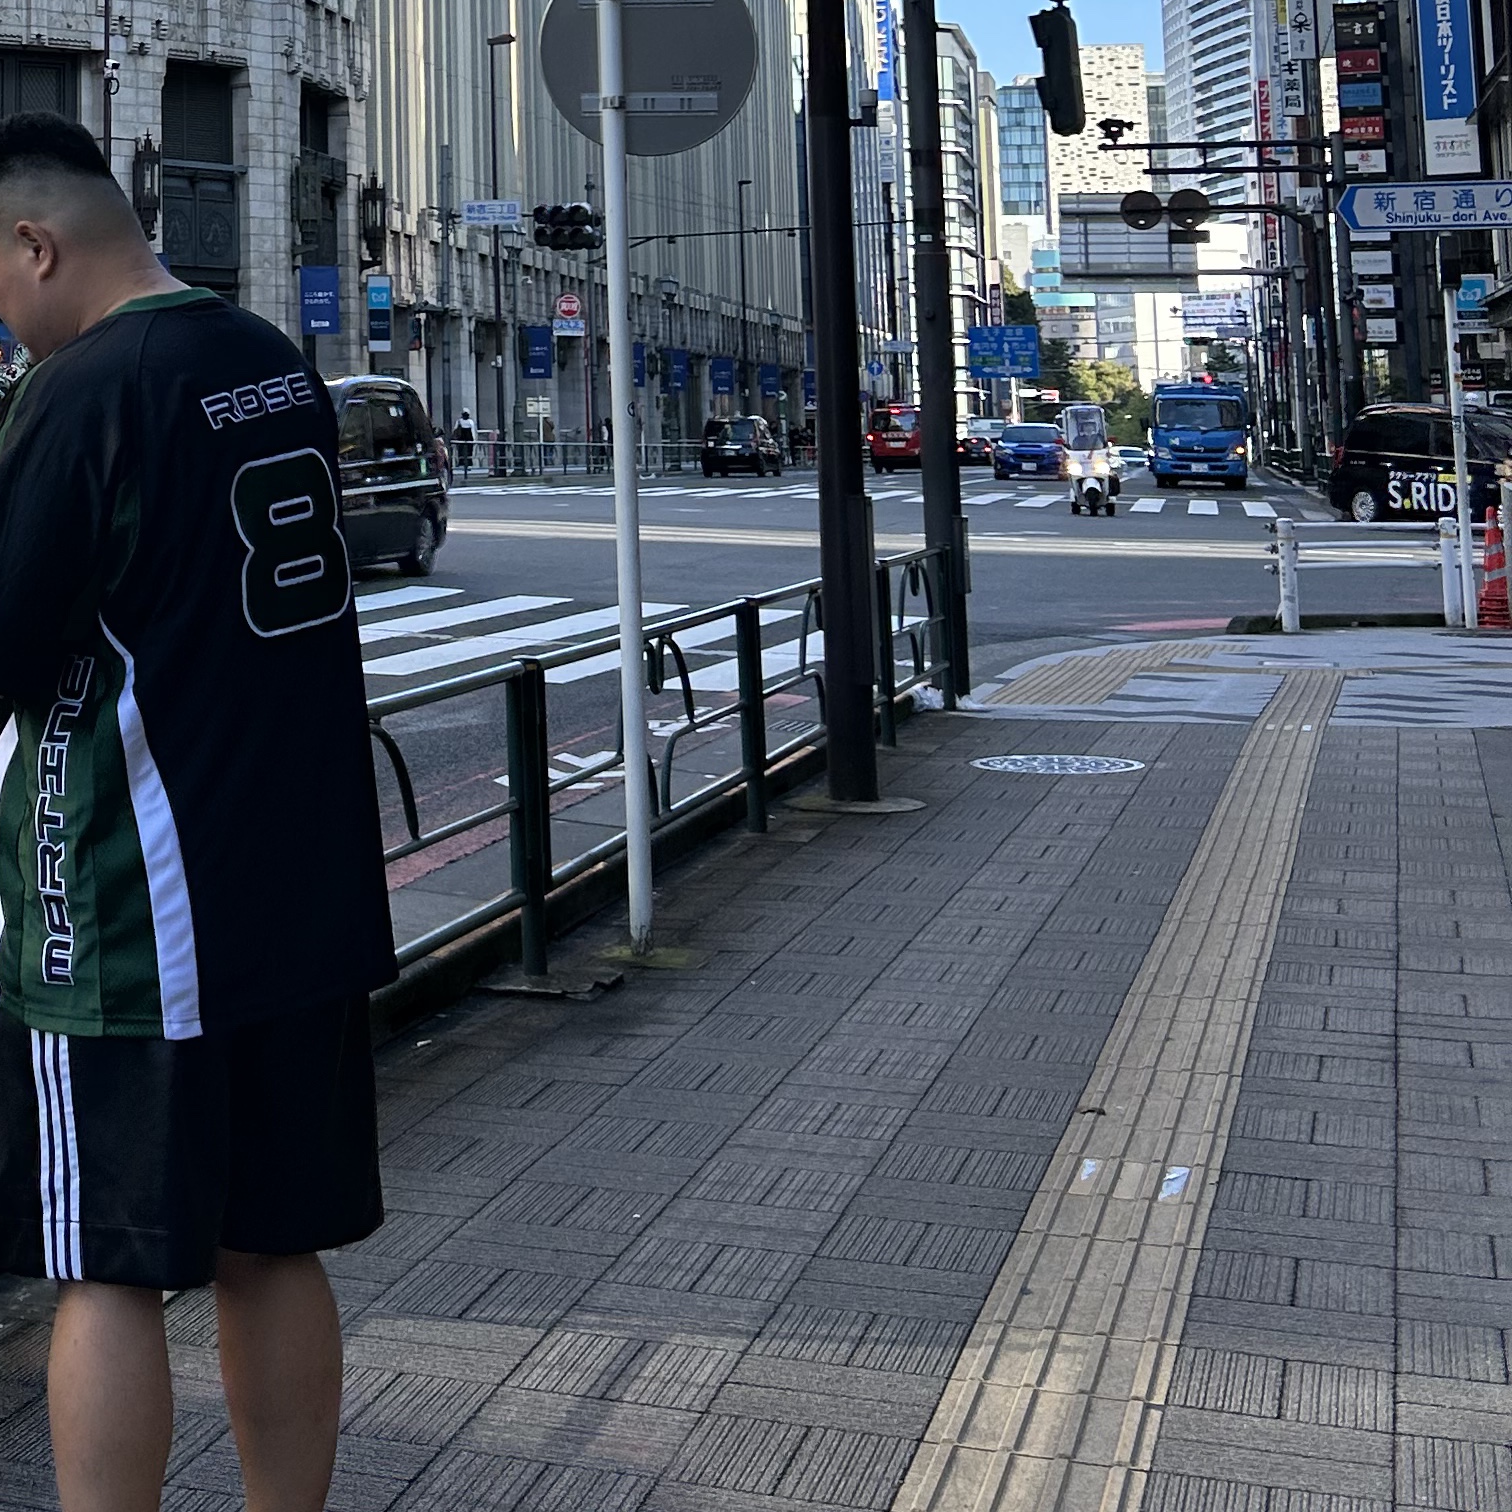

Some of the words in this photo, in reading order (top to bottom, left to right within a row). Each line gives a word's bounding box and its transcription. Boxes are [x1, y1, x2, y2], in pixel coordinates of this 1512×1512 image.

[1373, 187, 1512, 212] 新宿通り
[1385, 210, 1478, 225] Shinjuku-dori
[200, 372, 315, 431] ROSE
[1388, 480, 1472, 512] S.RID
[230, 447, 352, 639] 8
[34, 654, 96, 987] MARTINE
